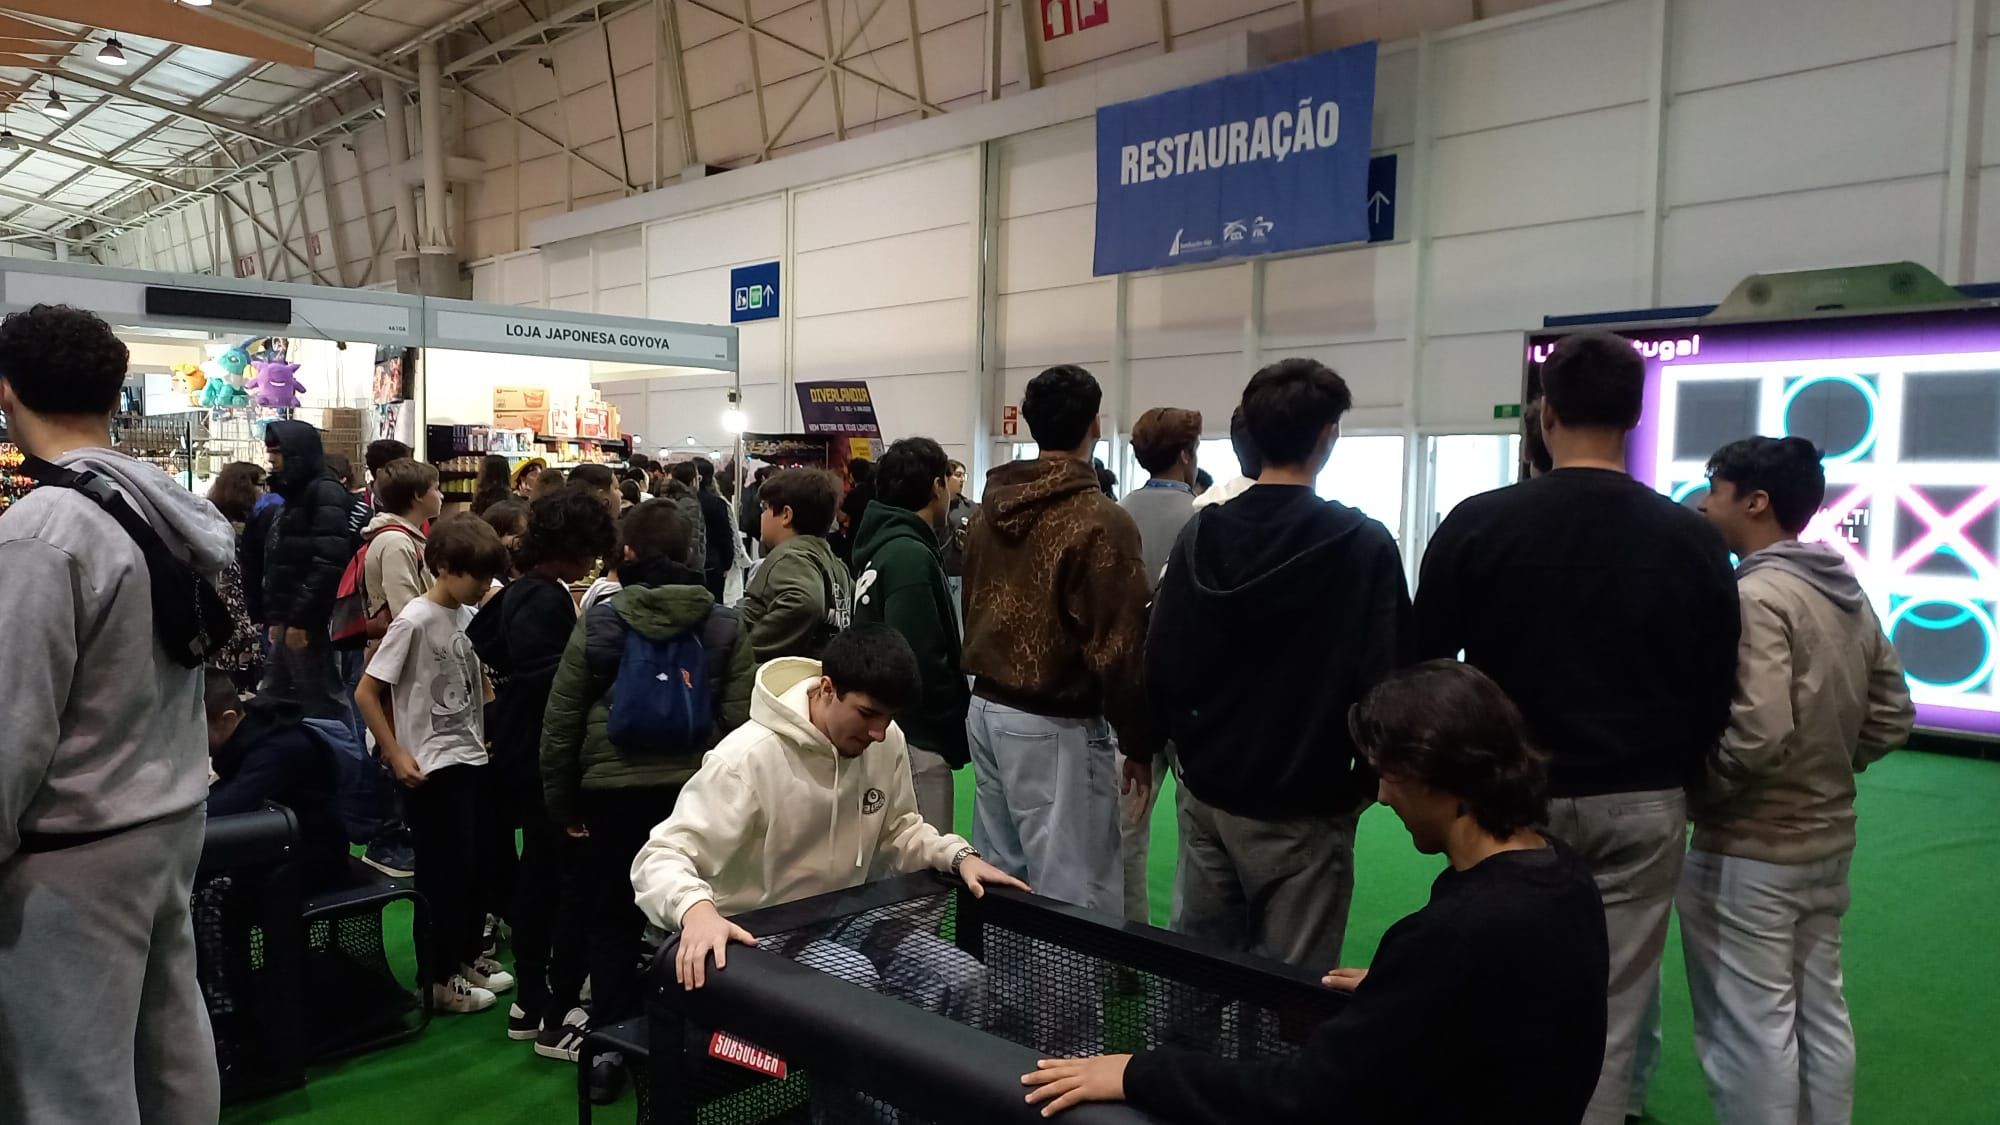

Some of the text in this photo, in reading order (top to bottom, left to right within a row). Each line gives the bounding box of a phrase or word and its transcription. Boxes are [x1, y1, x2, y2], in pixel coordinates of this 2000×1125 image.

[1120, 97, 1340, 186] RESTAURAÇÃO
[506, 323, 670, 350] LOJA JAPONESA GOYOYA
[809, 387, 869, 403] DIVERLANDIA
